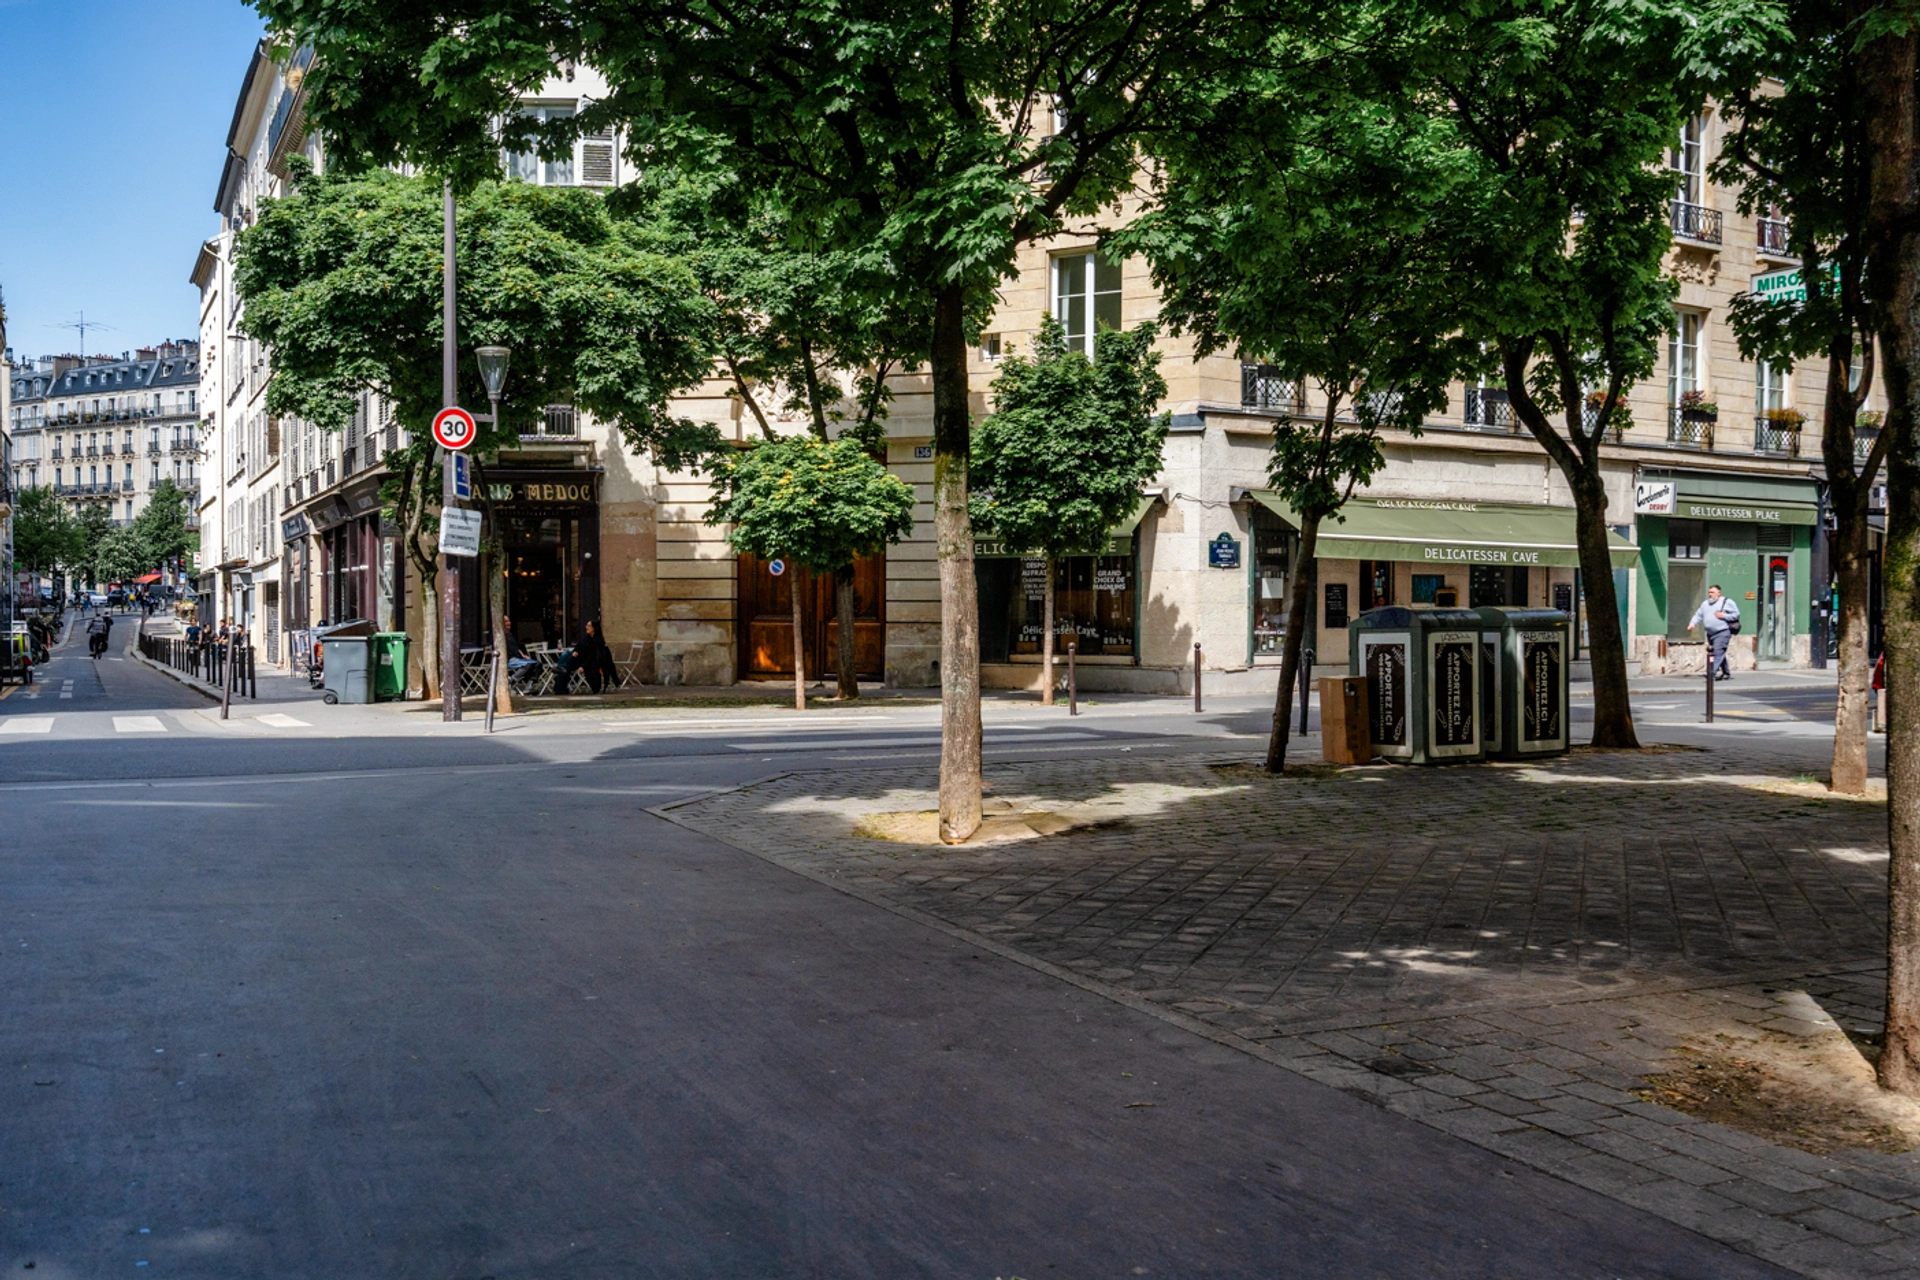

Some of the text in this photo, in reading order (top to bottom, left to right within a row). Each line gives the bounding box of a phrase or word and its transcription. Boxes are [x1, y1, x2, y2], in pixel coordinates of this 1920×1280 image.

[443, 421, 466, 437] 30
[470, 484, 514, 500] ARIS
[1690, 506, 1780, 520] DELICATESSEN PLACE
[1424, 548, 1539, 563] DELICATESSEN CAVE
[1384, 652, 1393, 726] APPORTEZ ICI
[1453, 652, 1461, 725] APPORTEZ ICI
